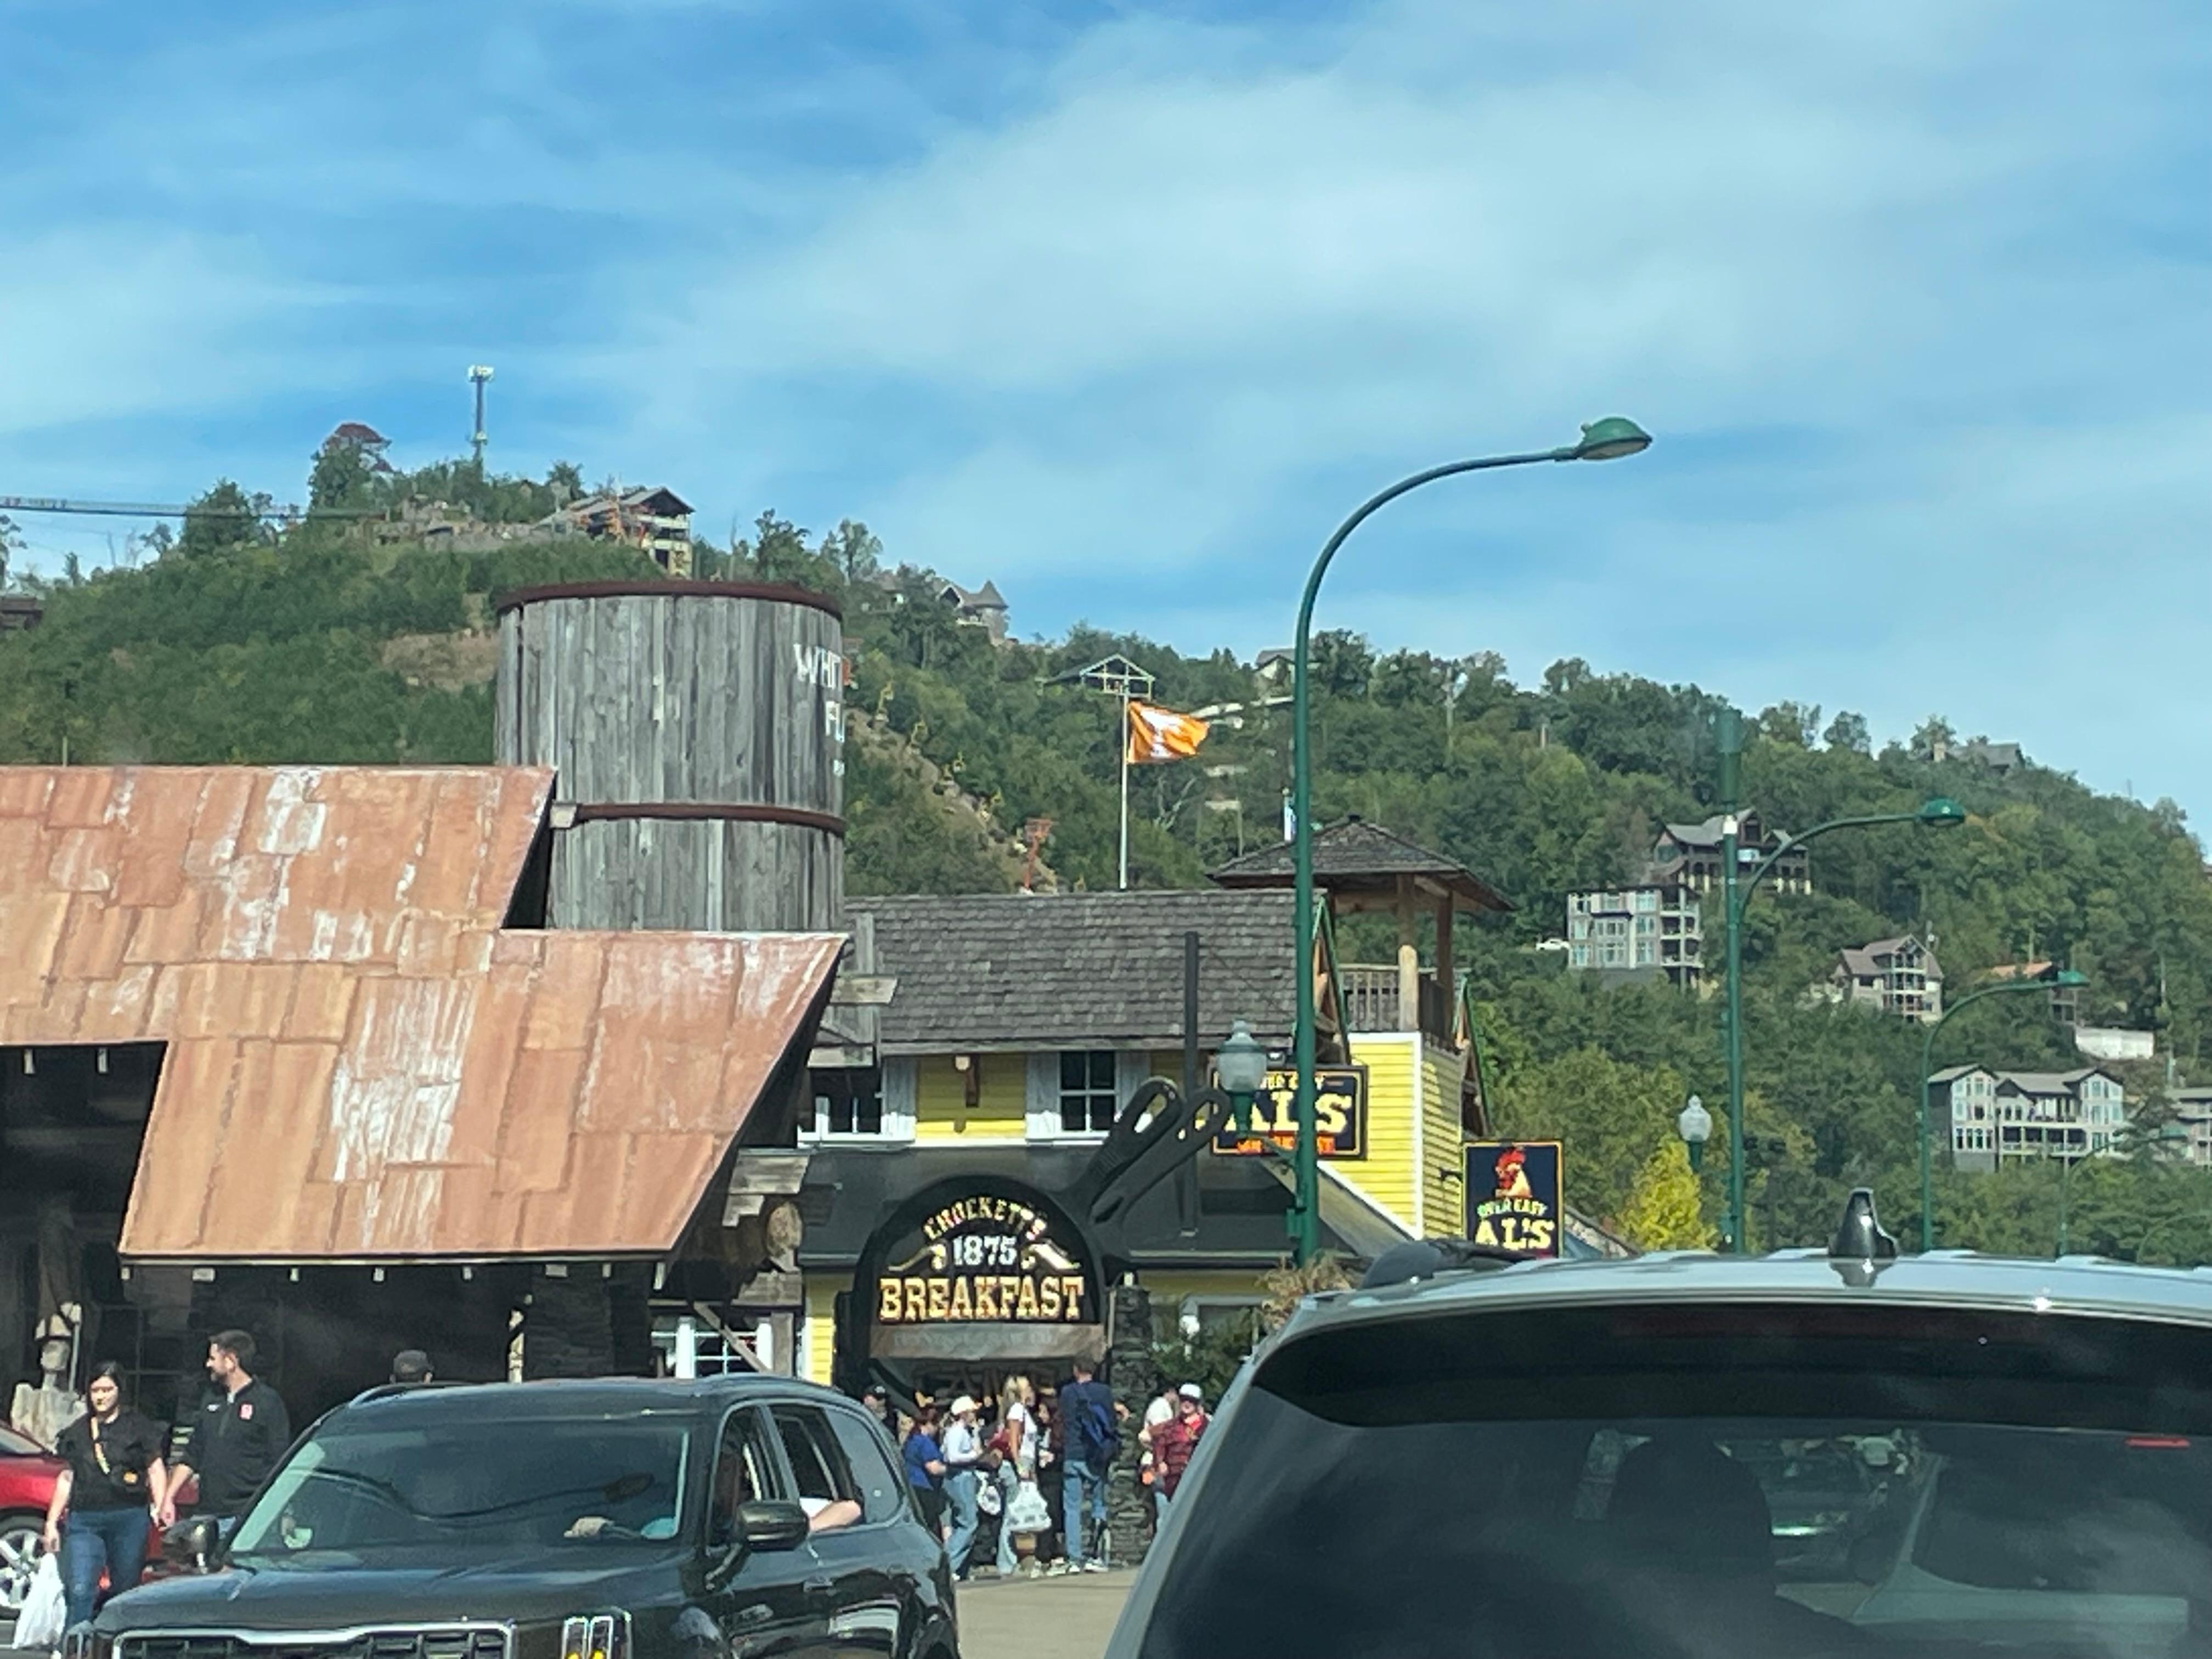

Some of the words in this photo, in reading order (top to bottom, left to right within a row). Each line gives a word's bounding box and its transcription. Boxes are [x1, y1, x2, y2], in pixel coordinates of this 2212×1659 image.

[952, 1234, 1018, 1266] 1875
[1475, 1217, 1555, 1251] AL'S
[879, 1274, 1085, 1322] BREAKFAST
